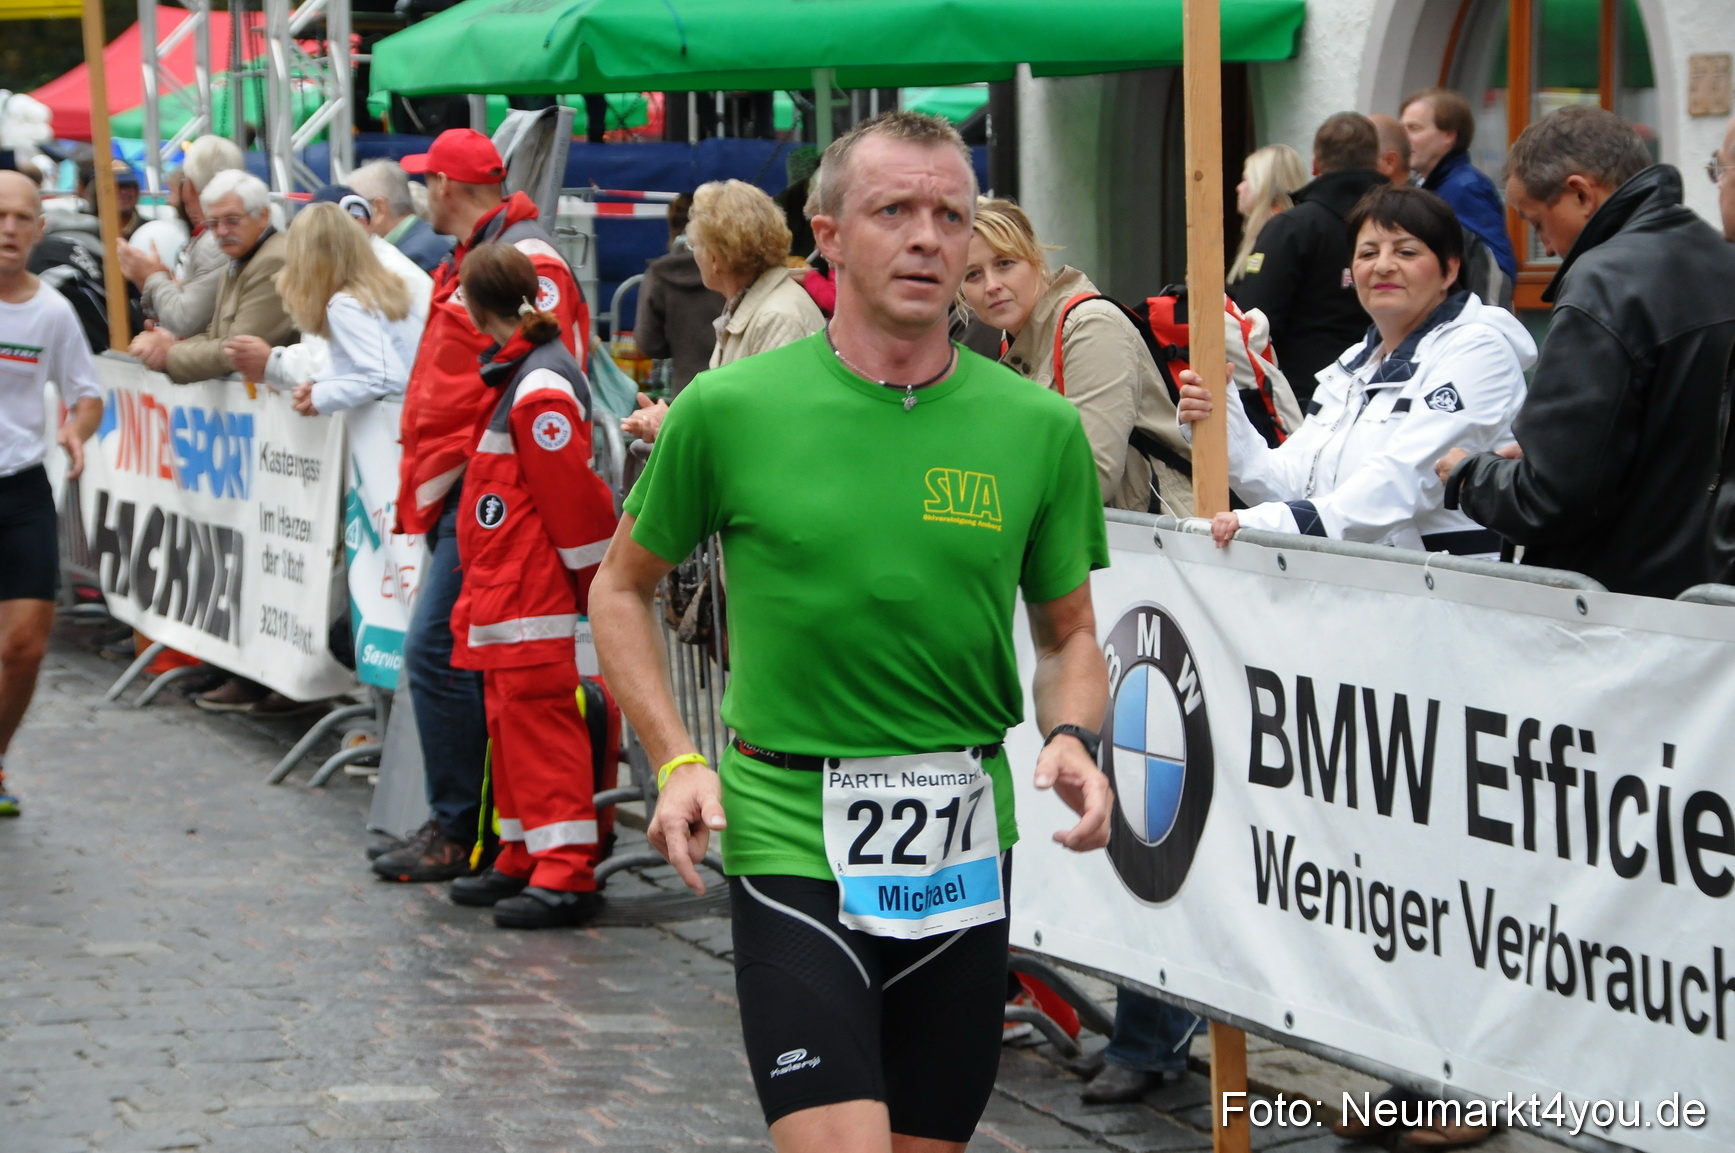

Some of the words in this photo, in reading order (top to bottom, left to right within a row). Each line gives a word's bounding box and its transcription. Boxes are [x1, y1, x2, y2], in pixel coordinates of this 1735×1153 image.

[114, 387, 255, 501] INTESPORT
[924, 467, 1002, 522] SVA
[362, 643, 402, 671] Servic
[1103, 612, 1203, 716] BMW
[829, 771, 896, 788] PARTL
[1245, 665, 1440, 826] BMW
[1464, 705, 1735, 899] Efficie
[847, 786, 985, 865] 2217
[878, 874, 967, 912] Michael
[1250, 825, 1450, 963] Weniger
[1459, 880, 1735, 1042] Verbrauch
